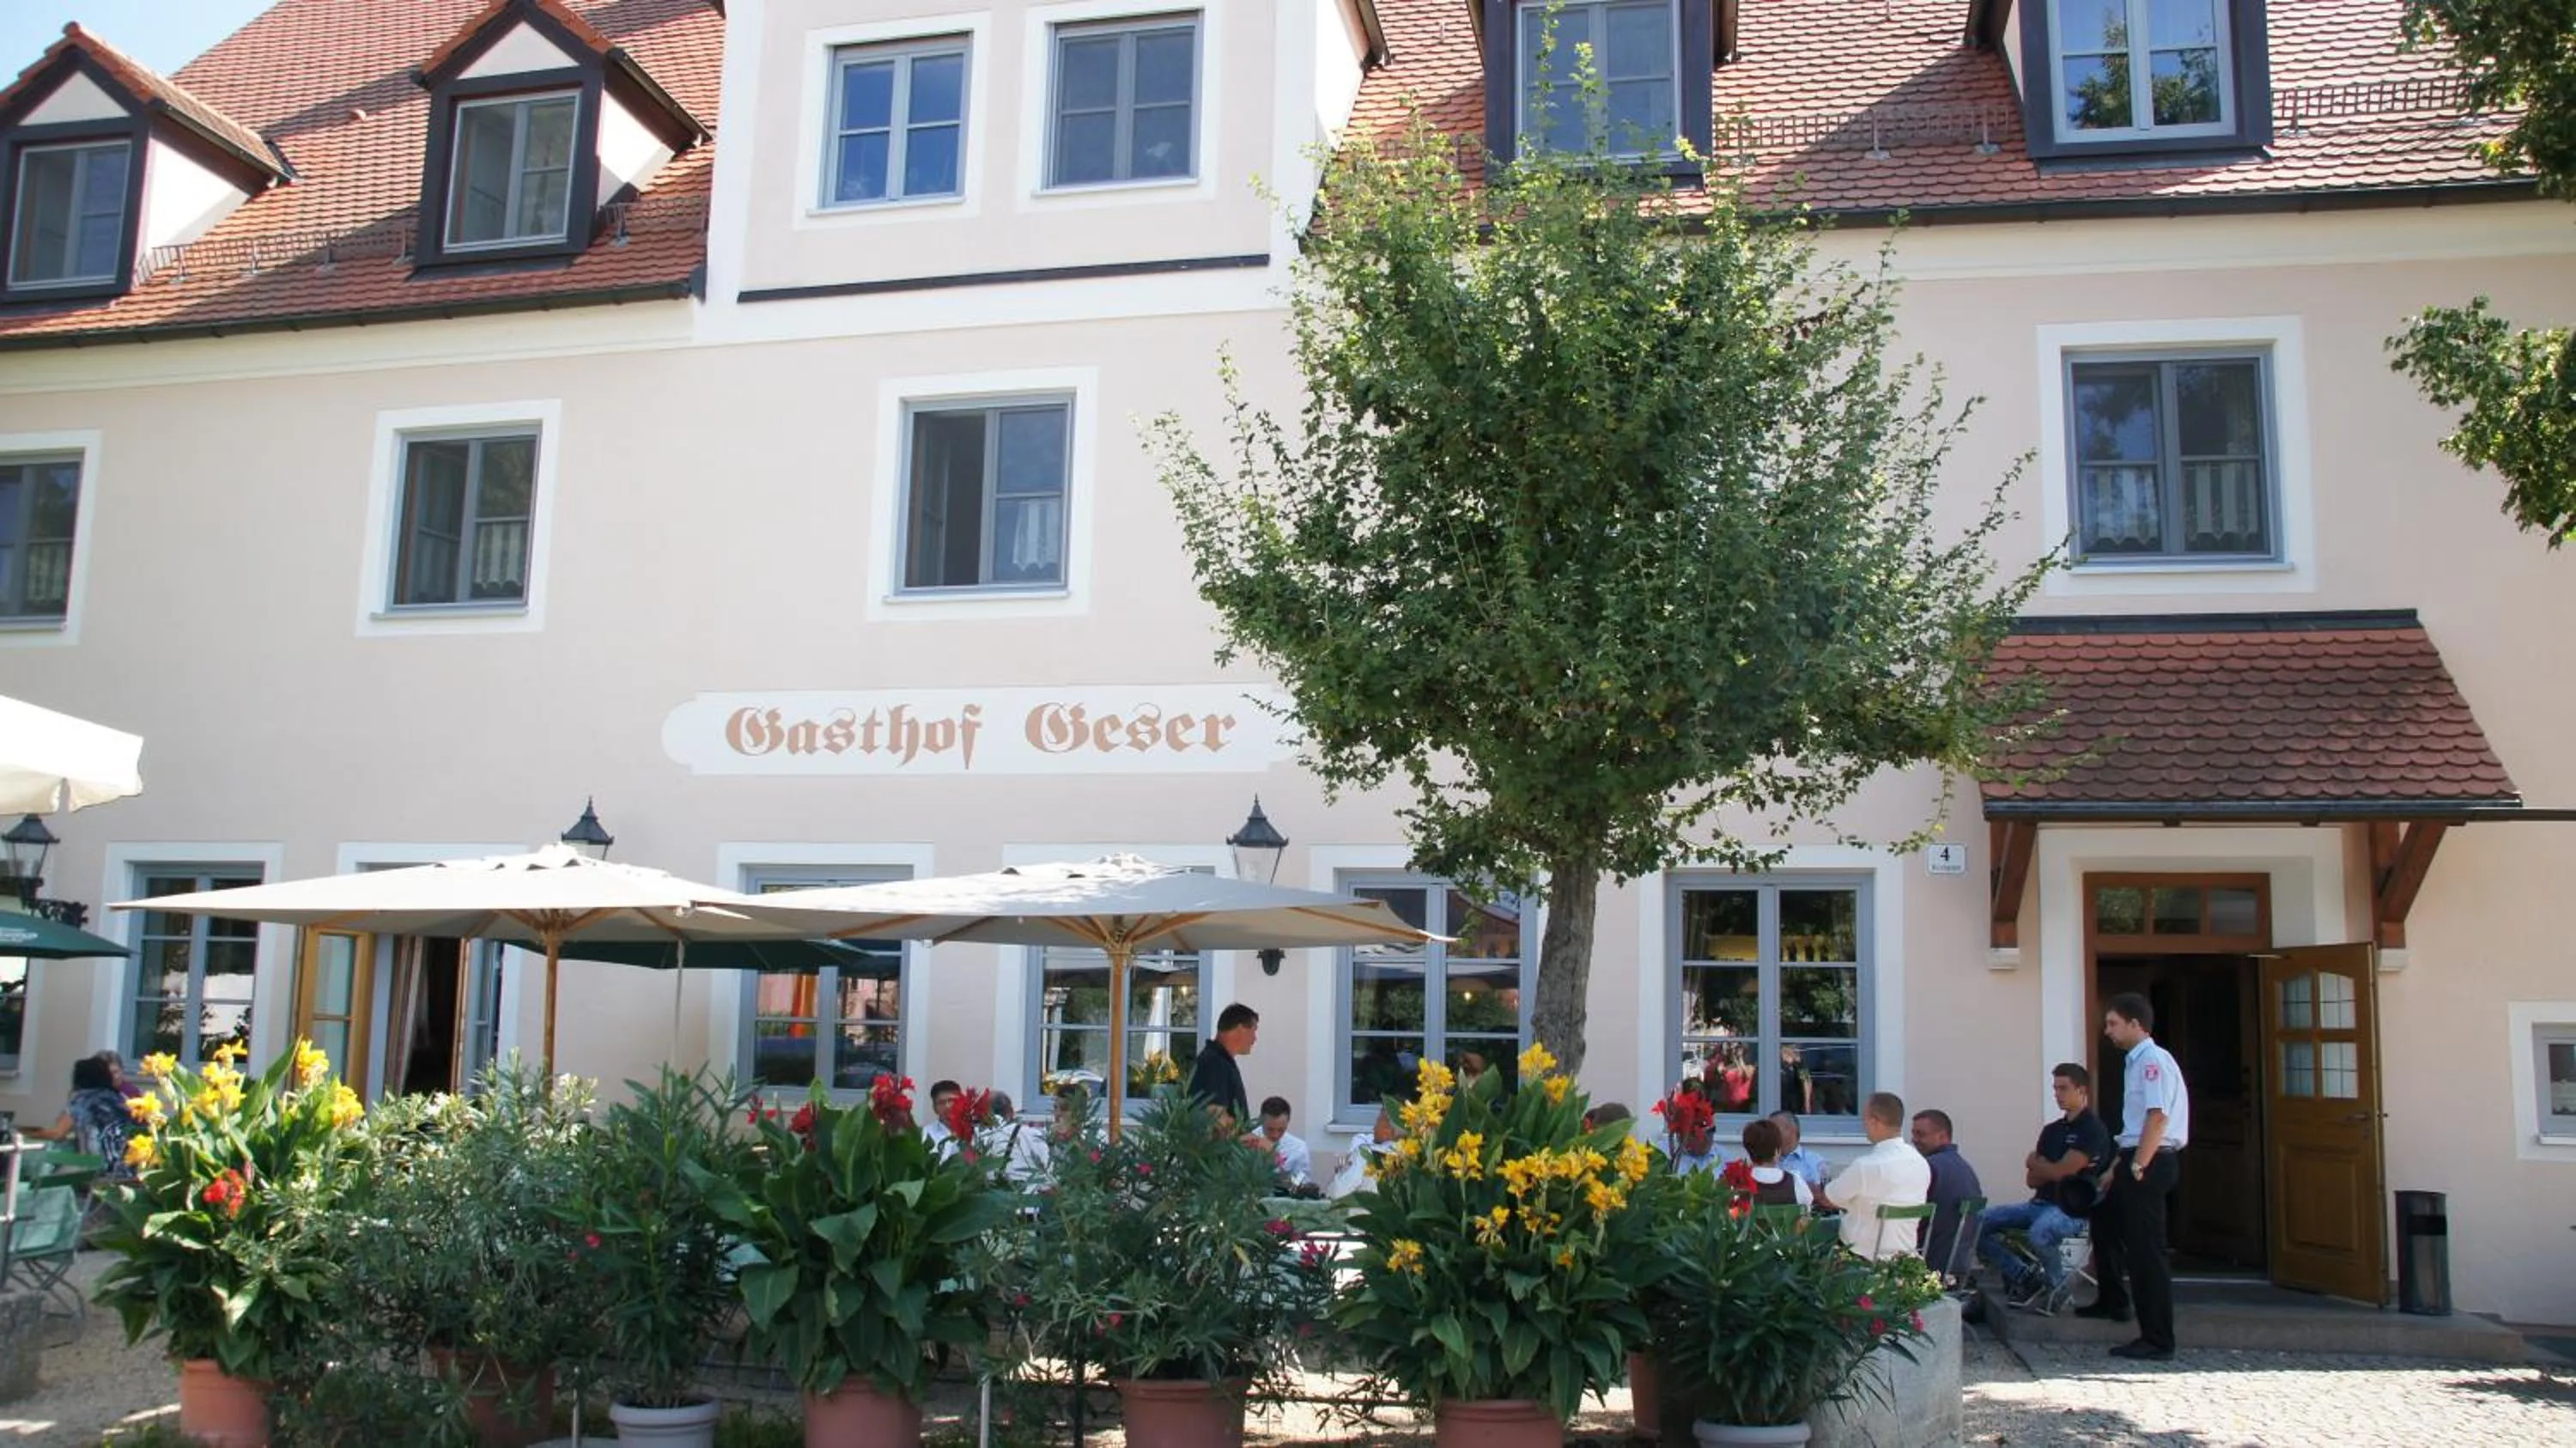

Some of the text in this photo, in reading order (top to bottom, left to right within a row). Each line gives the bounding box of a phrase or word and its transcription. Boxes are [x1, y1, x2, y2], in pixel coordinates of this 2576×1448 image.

[725, 702, 1237, 770] Gasthof Geser
[1940, 846, 1950, 861] 4
